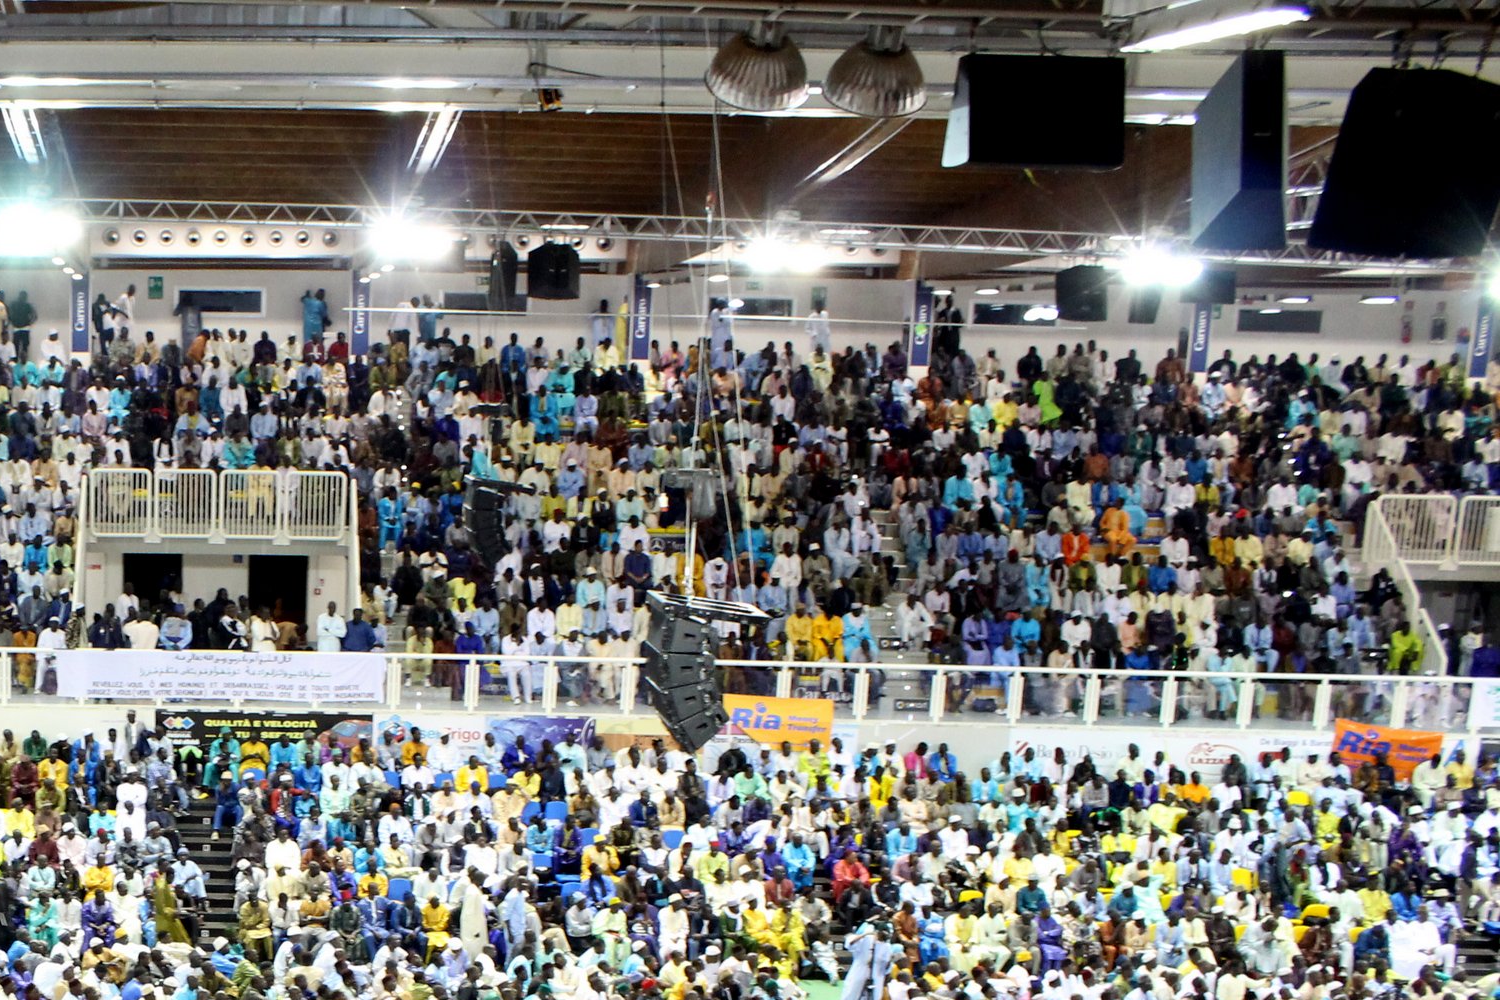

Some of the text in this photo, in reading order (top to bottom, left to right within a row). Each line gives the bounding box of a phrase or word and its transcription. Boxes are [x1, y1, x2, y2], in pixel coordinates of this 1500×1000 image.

[203, 718, 318, 729] QUALITÀ E VELOCITÀ
[731, 703, 782, 730] Ria
[1338, 730, 1392, 755] Ria
